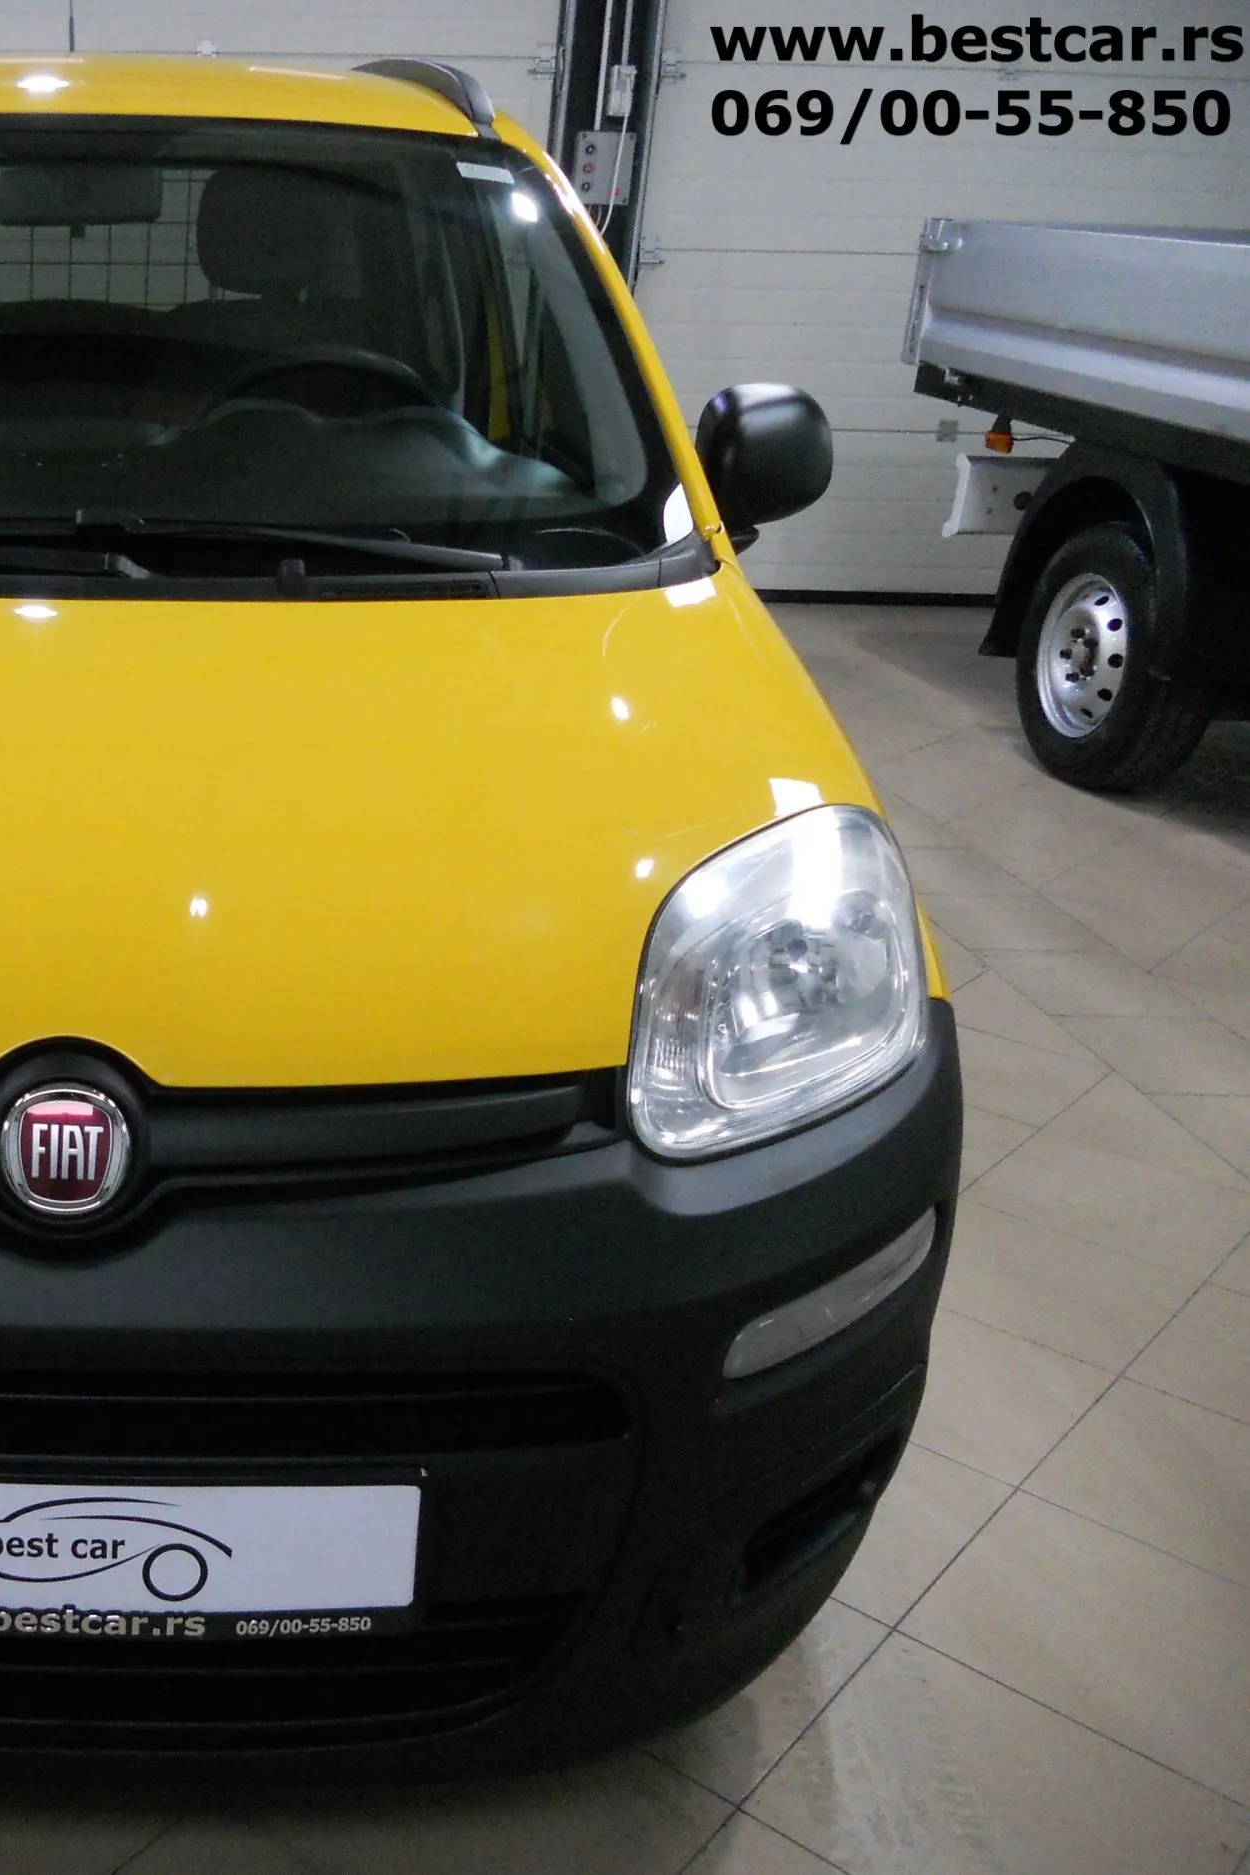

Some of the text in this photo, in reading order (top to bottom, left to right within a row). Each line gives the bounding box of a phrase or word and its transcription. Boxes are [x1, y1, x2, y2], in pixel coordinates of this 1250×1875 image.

[31, 1122, 104, 1181] FIAT
[70, 1538, 126, 1560] car
[235, 1616, 372, 1638] 069/00-55-850
